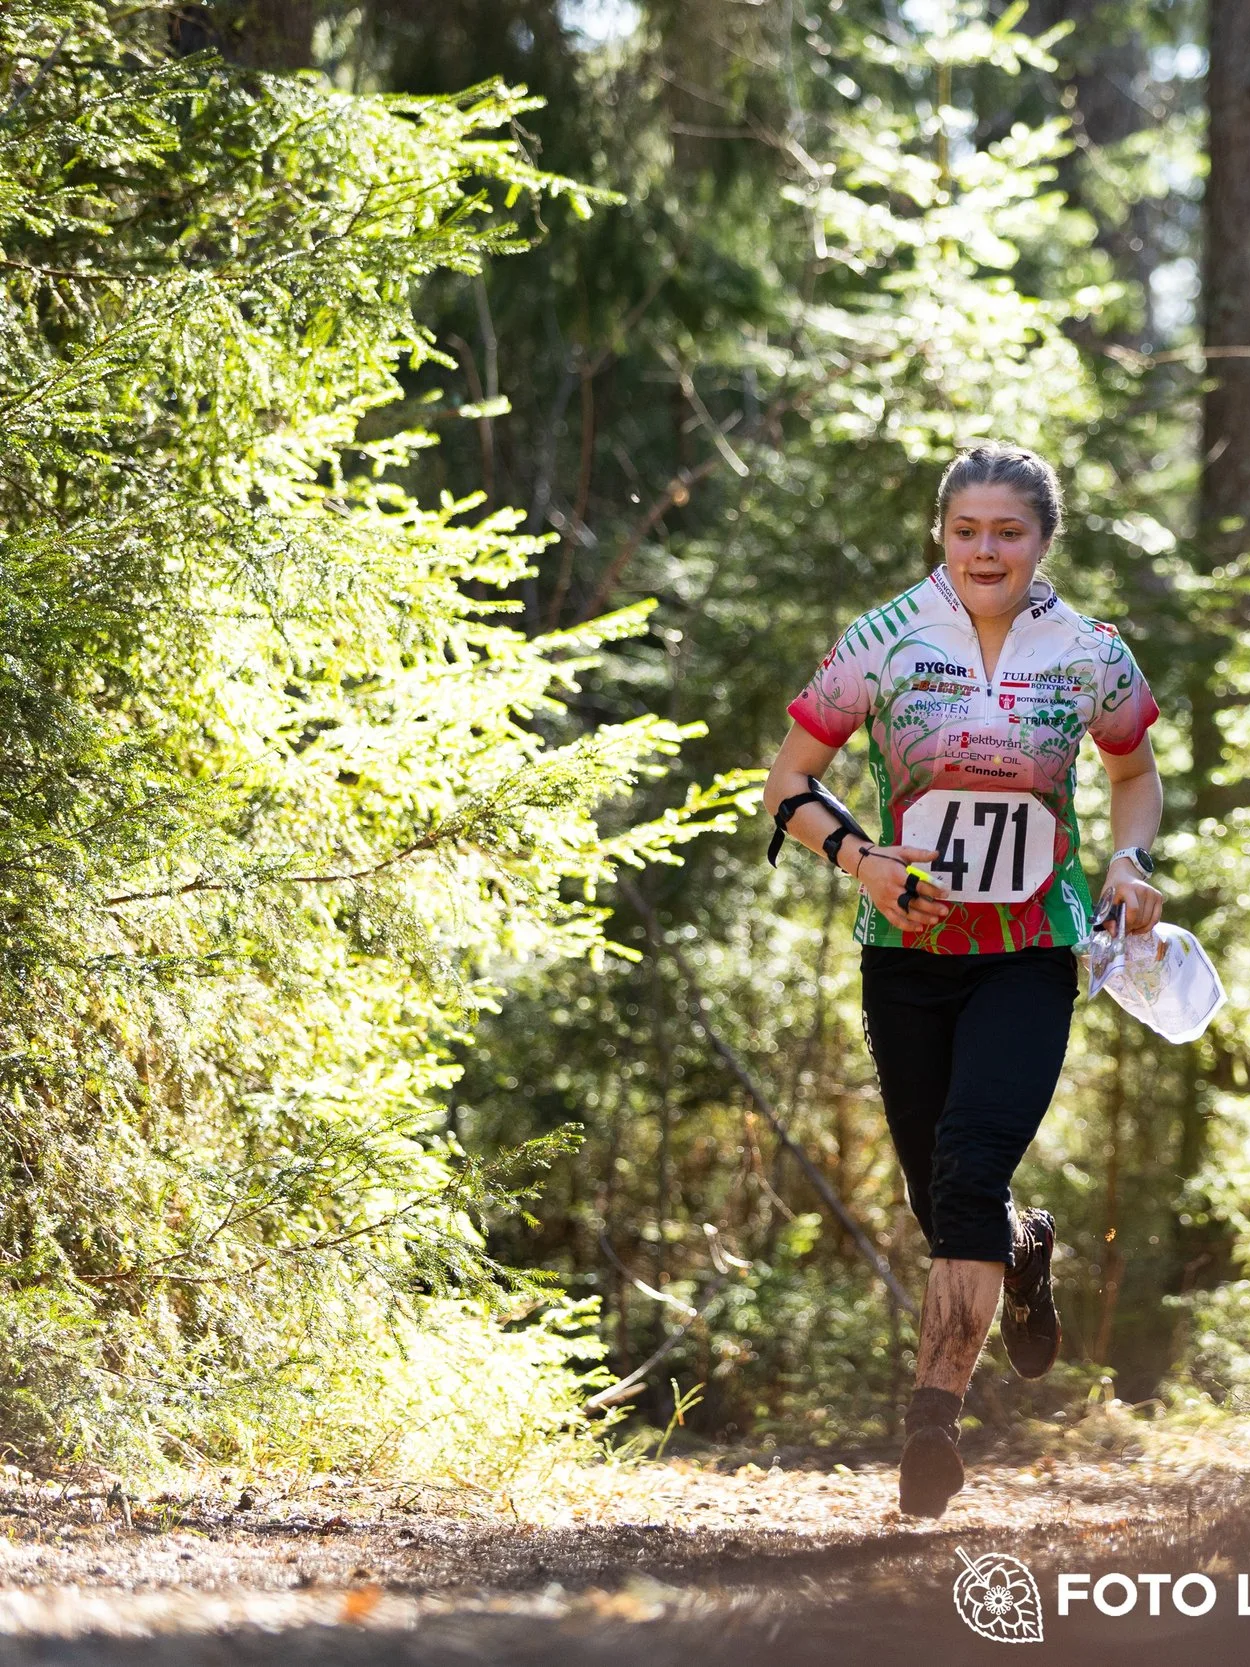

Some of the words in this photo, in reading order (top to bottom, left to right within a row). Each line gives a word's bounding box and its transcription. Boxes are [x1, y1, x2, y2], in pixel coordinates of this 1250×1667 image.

[915, 661, 977, 679] BYGGR1
[1002, 671, 1065, 684] TULLINGE
[1066, 675, 1082, 685] SK
[1031, 683, 1071, 691] BOTKYRKA
[915, 699, 969, 715] RIKSTEN
[1023, 716, 1066, 726] TRIMTEX
[948, 733, 1022, 749] projektbyrån
[944, 751, 994, 761] LUCENT
[1002, 756, 1022, 765] OIL
[964, 765, 1018, 778] Cinnober
[930, 801, 1029, 892] 471
